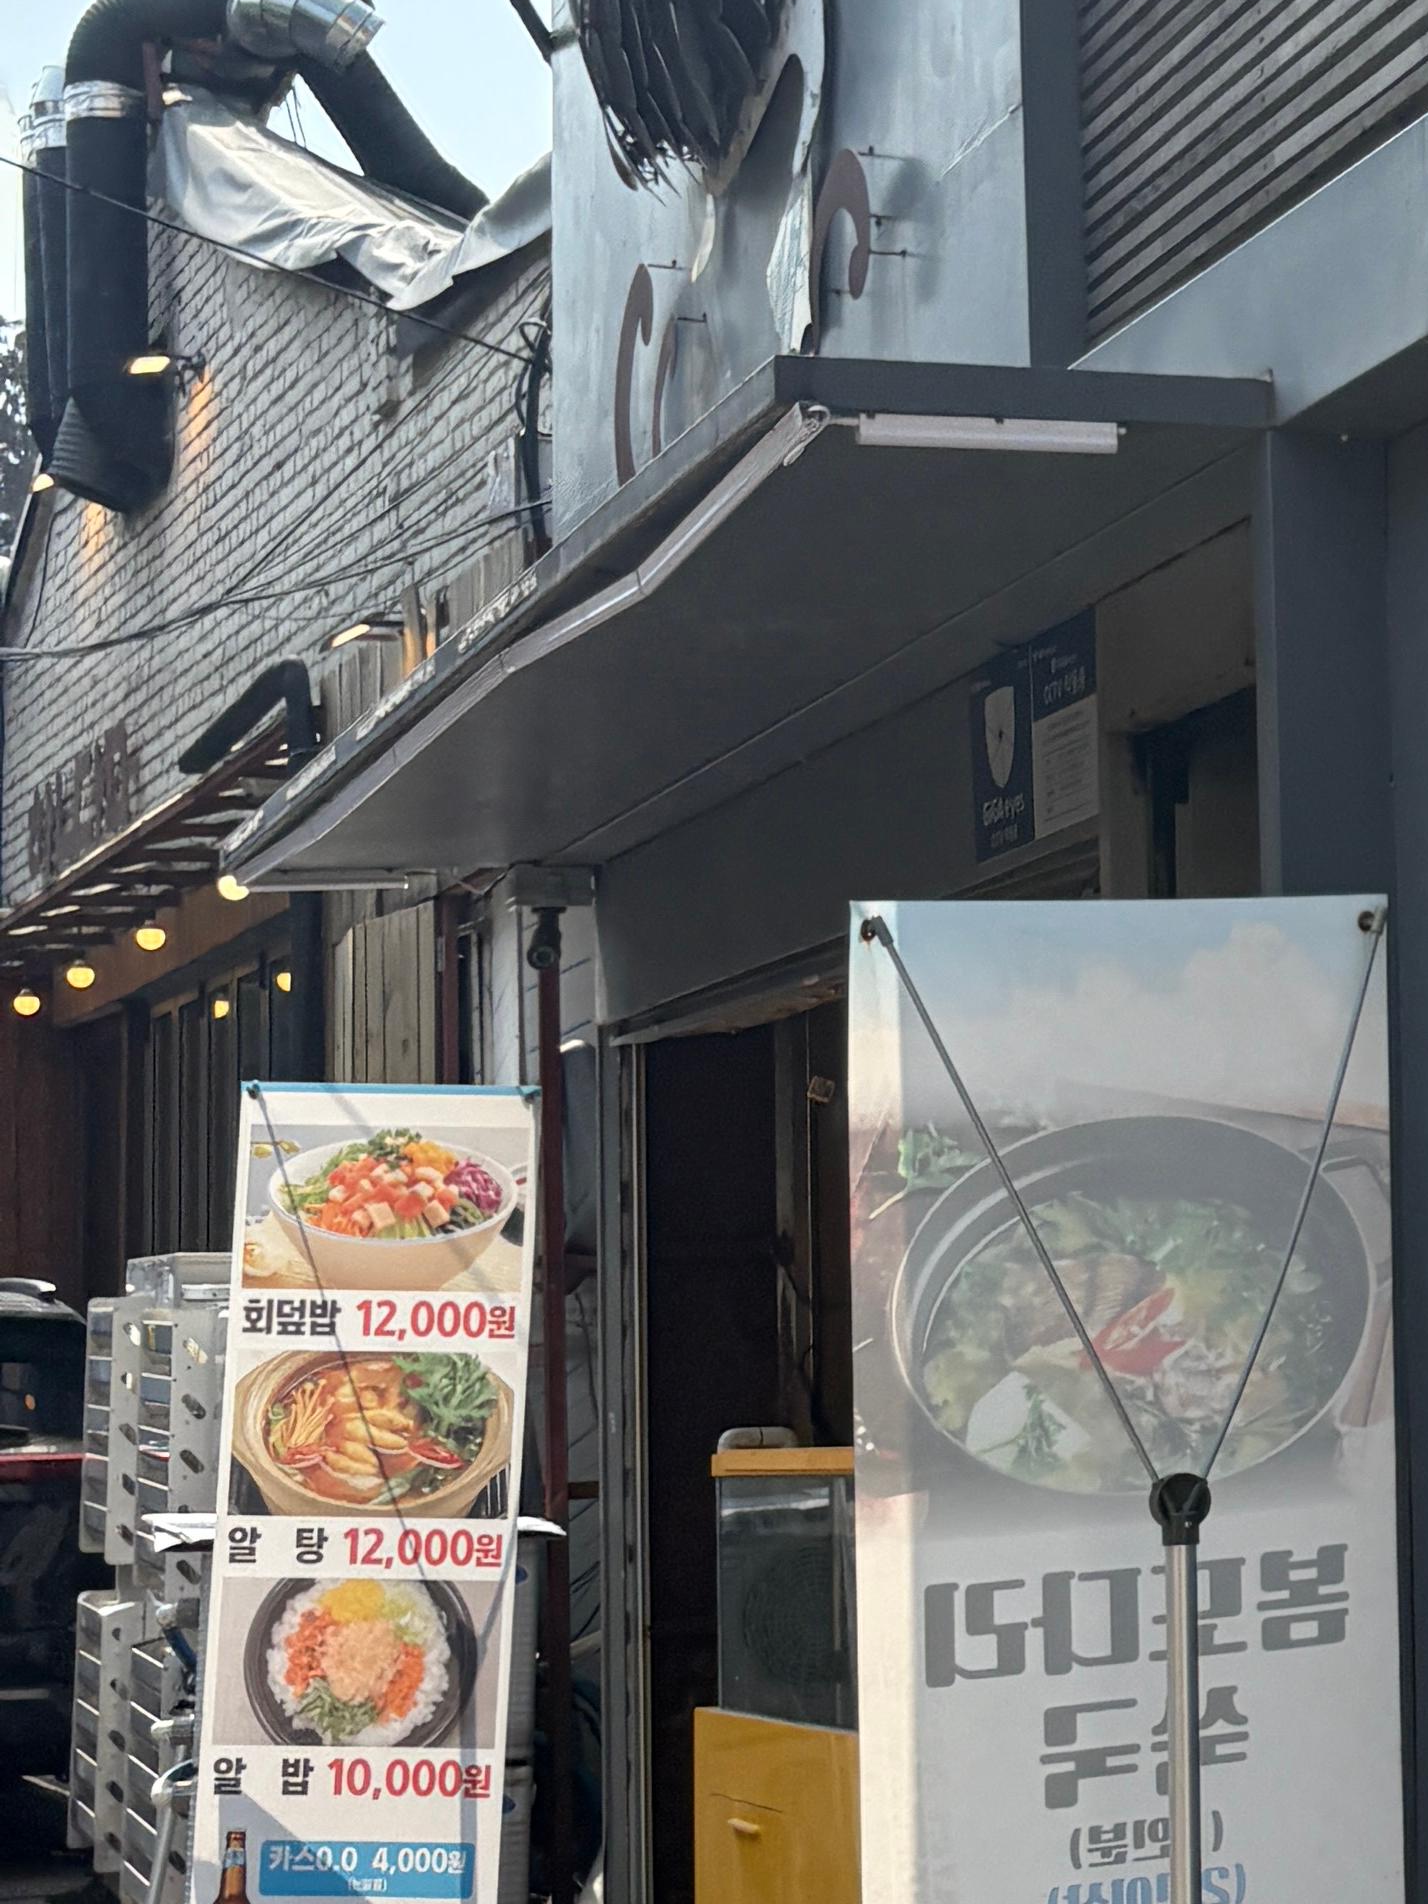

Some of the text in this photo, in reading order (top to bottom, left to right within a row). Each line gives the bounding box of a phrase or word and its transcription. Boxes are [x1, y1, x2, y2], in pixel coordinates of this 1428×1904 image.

[242, 1299, 516, 1341] 회덮밥 12,000원
[343, 1528, 503, 1569] 12,000원
[327, 1758, 491, 1803] 10,000원
[268, 1846, 358, 1872] 카스0.0
[371, 1847, 466, 1875] 4,000원
